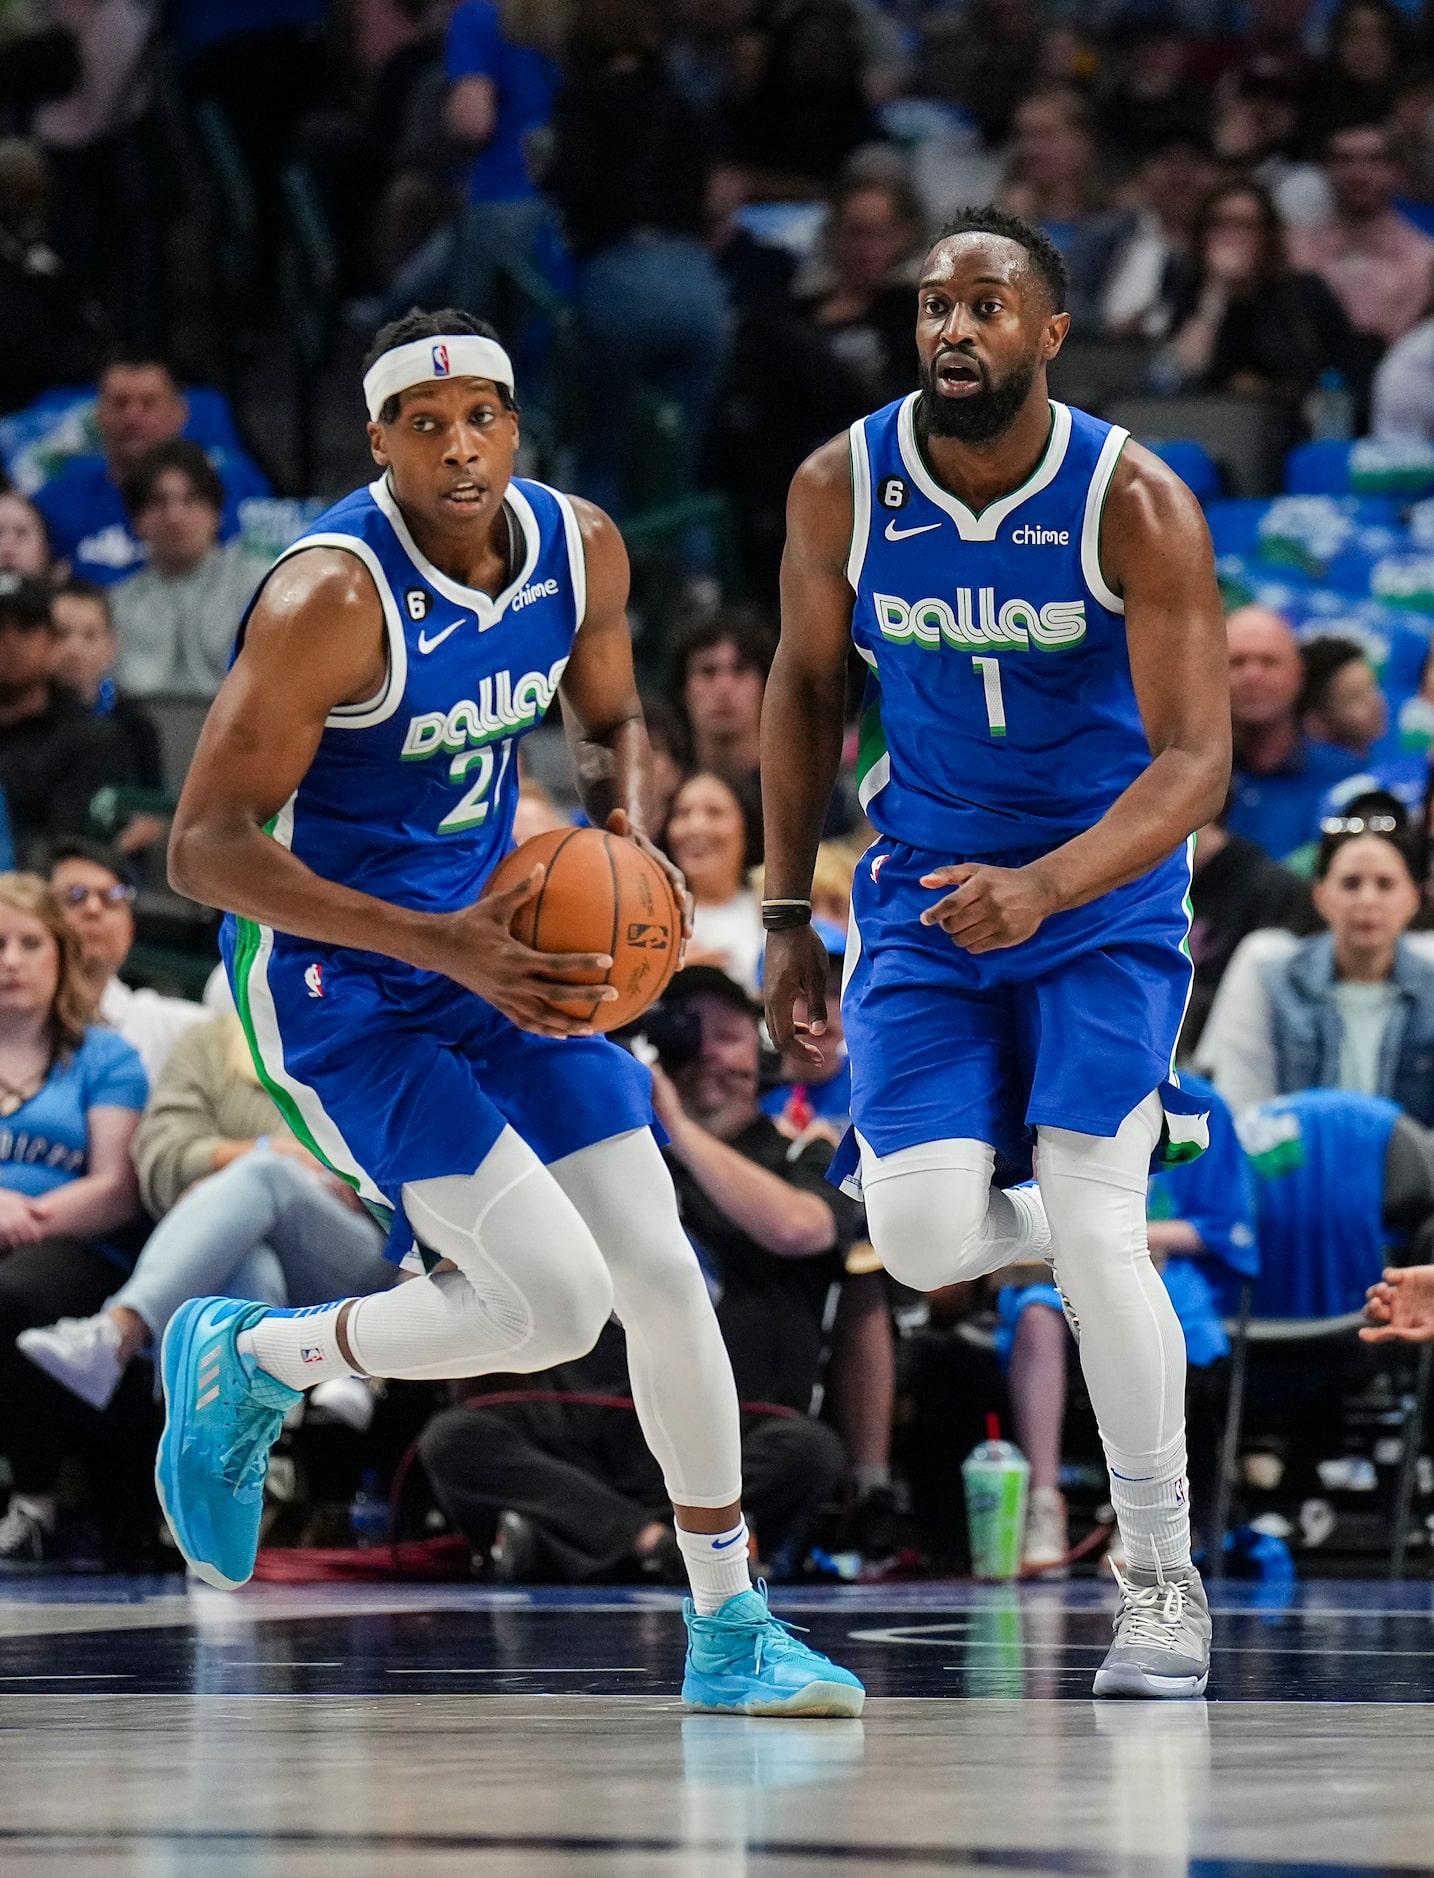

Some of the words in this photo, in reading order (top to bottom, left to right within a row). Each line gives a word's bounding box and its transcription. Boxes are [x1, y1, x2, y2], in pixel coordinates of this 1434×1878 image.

[883, 479, 905, 508] 6
[1011, 524, 1070, 547] chime
[406, 590, 427, 620] 6
[511, 578, 559, 612] chime
[971, 655, 1007, 737] 1
